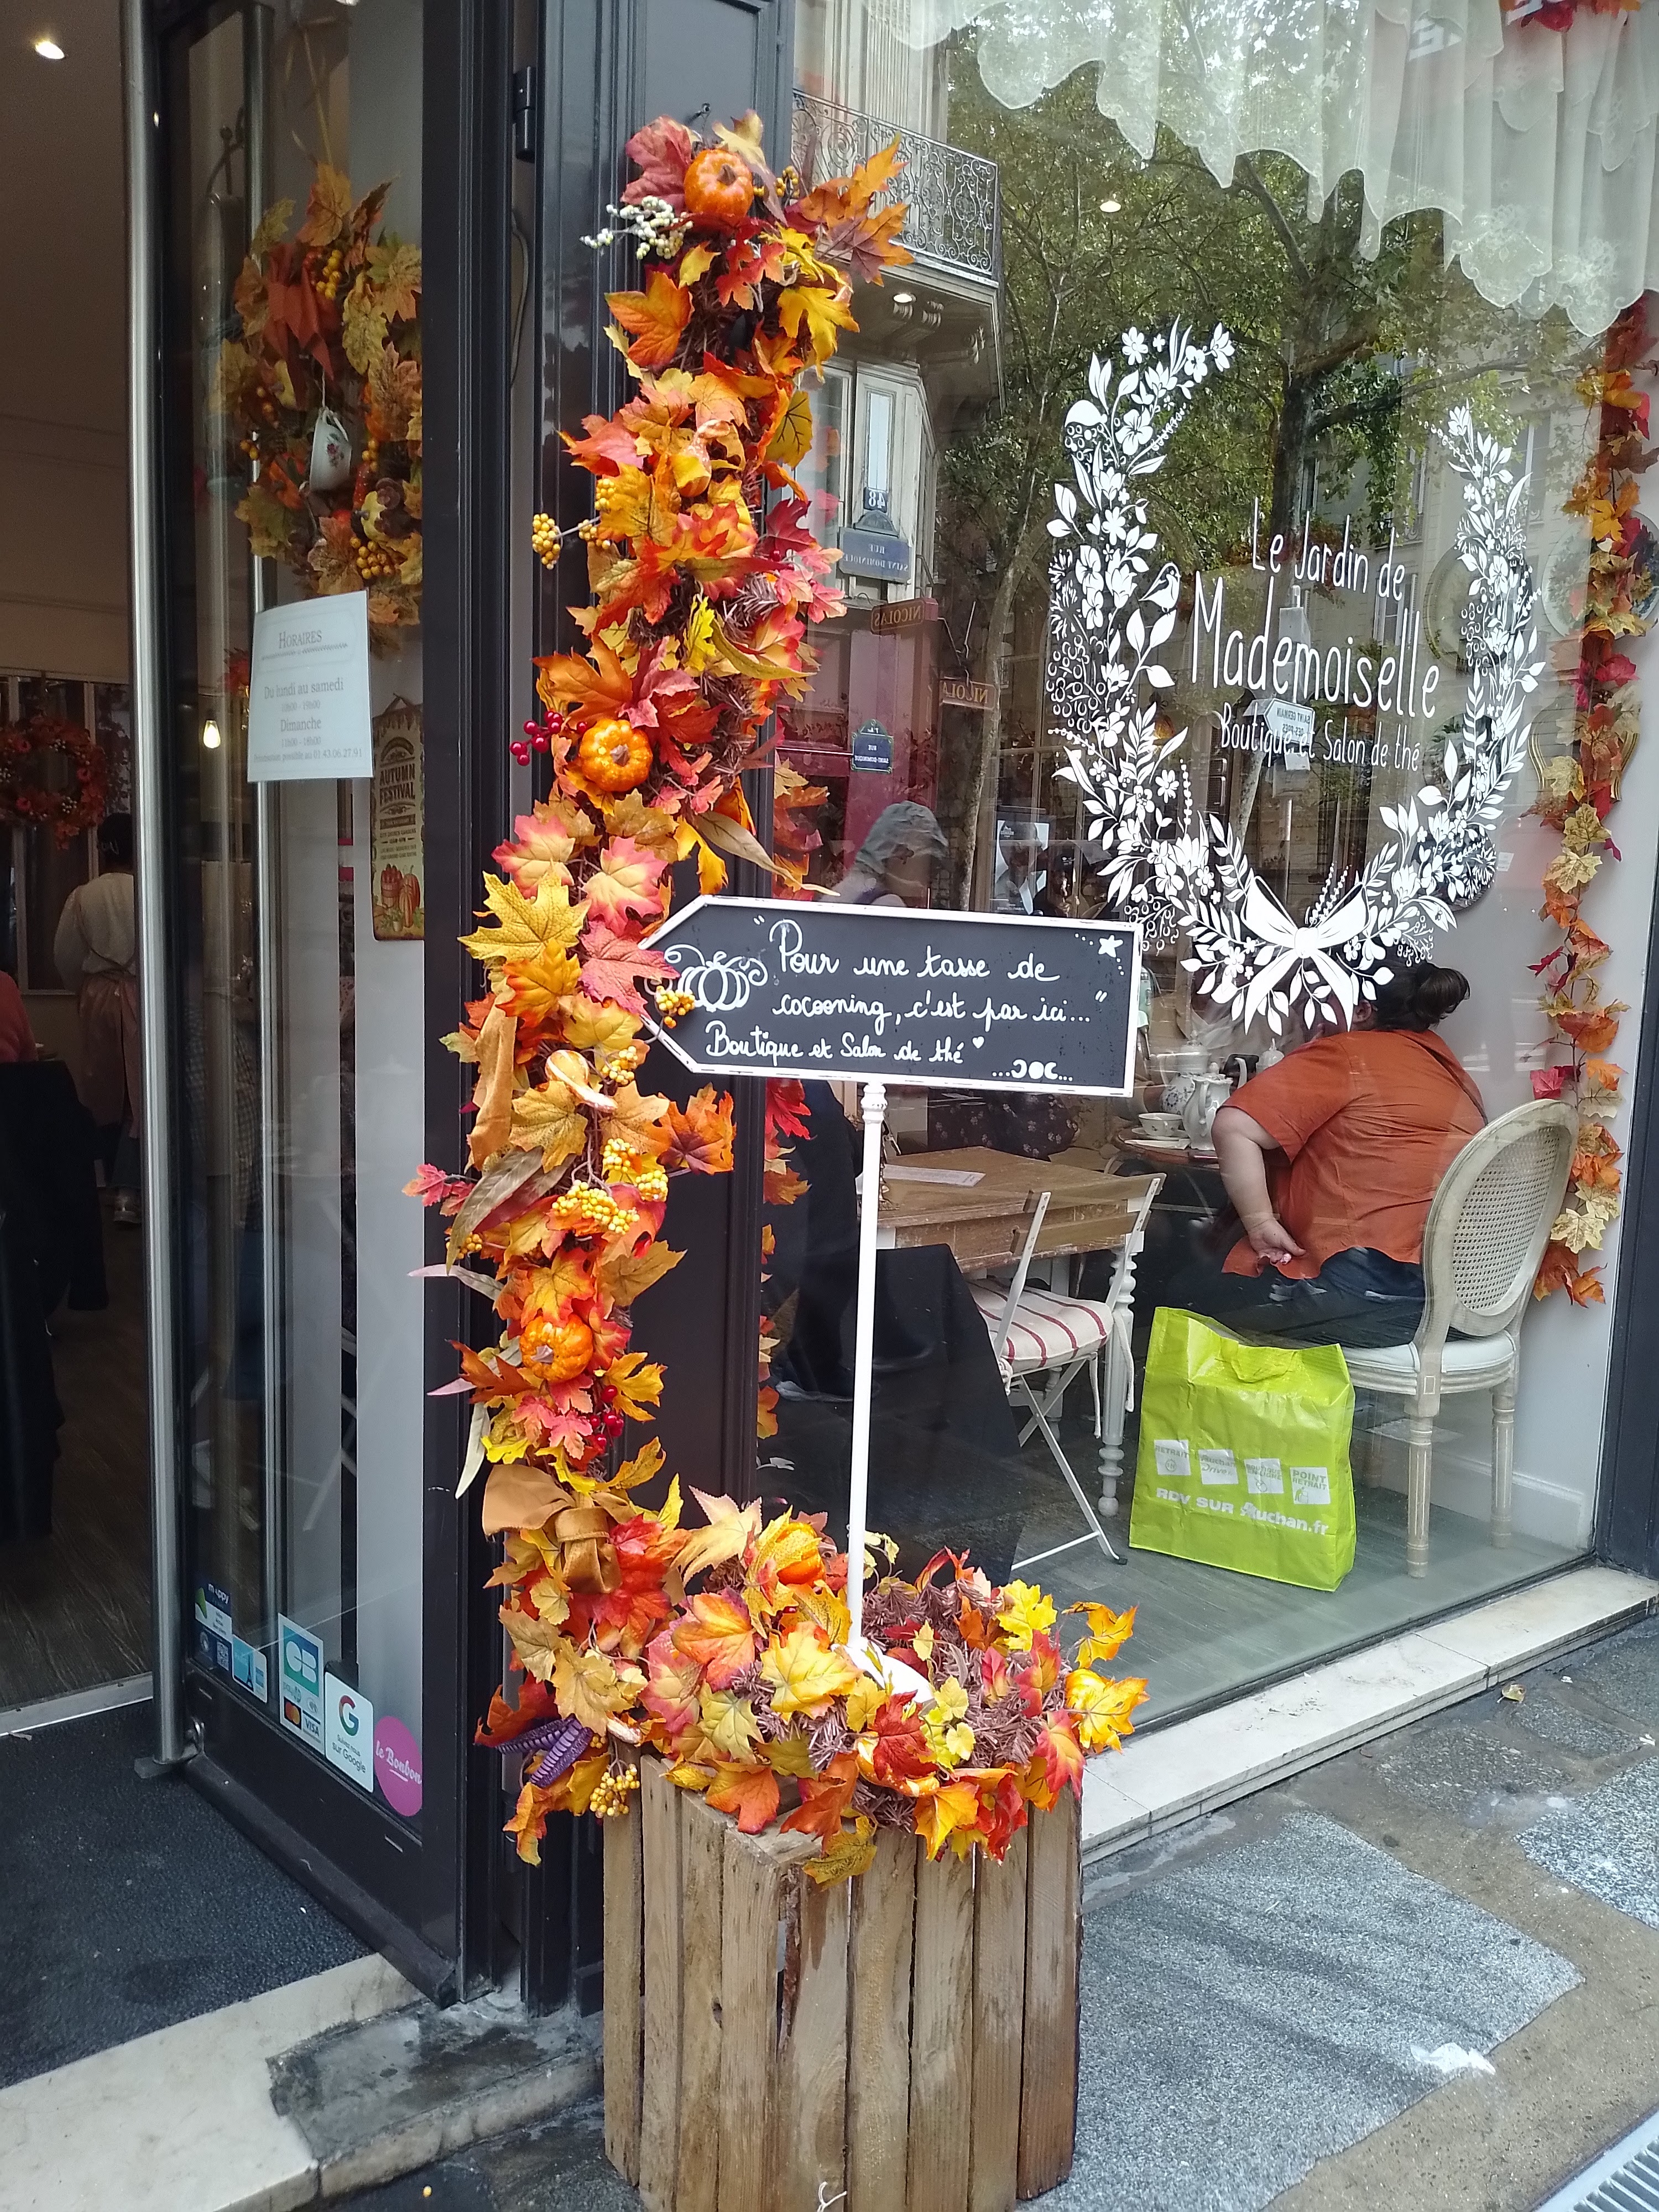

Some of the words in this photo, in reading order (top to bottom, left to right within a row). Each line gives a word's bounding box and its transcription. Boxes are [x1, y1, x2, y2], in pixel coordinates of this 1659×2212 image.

[1252, 497, 1284, 573] Le
[1295, 510, 1369, 593] Jardin
[1378, 527, 1405, 601] de
[1192, 571, 1439, 718] Mademoiselle
[264, 686, 274, 699] Du
[276, 682, 295, 697] lundi
[298, 685, 308, 694] au
[311, 677, 344, 693] samedi
[280, 717, 321, 732] Dimanche
[1220, 702, 1292, 767] Boutique
[1300, 711, 1315, 758] et
[1323, 719, 1365, 765] Salon
[1371, 722, 1387, 768] de
[1394, 723, 1420, 771] thé
[380, 764, 415, 786] AUTUMN
[380, 782, 415, 806] FESTIVAL
[853, 957, 910, 976] une
[916, 945, 990, 978] tasse
[1008, 952, 1060, 982] de
[772, 994, 901, 1036] cocooning,
[904, 990, 966, 1019] c'est
[972, 998, 1027, 1032] par
[705, 1020, 804, 1066] Boutique
[808, 1039, 833, 1059] et
[841, 1032, 886, 1058] Salon
[894, 1041, 922, 1061] de
[928, 1036, 964, 1063] thé
[1155, 1445, 1189, 1458] RETRAIT
[1201, 1454, 1235, 1467] Auchan
[1246, 1464, 1281, 1475] BOUTIQUE
[1260, 1471, 1282, 1480] LIGNE
[1293, 1469, 1326, 1483] POINT
[1293, 1477, 1327, 1490] RETRAIT
[1156, 1488, 1191, 1504] RDV
[1196, 1496, 1234, 1514] SUR
[1240, 1501, 1329, 1536] Auchan.fr
[304, 1718, 319, 1737] VISA
[332, 1742, 342, 1754] sur
[343, 1748, 366, 1773] Google
[385, 1746, 422, 1785] Bonbon
